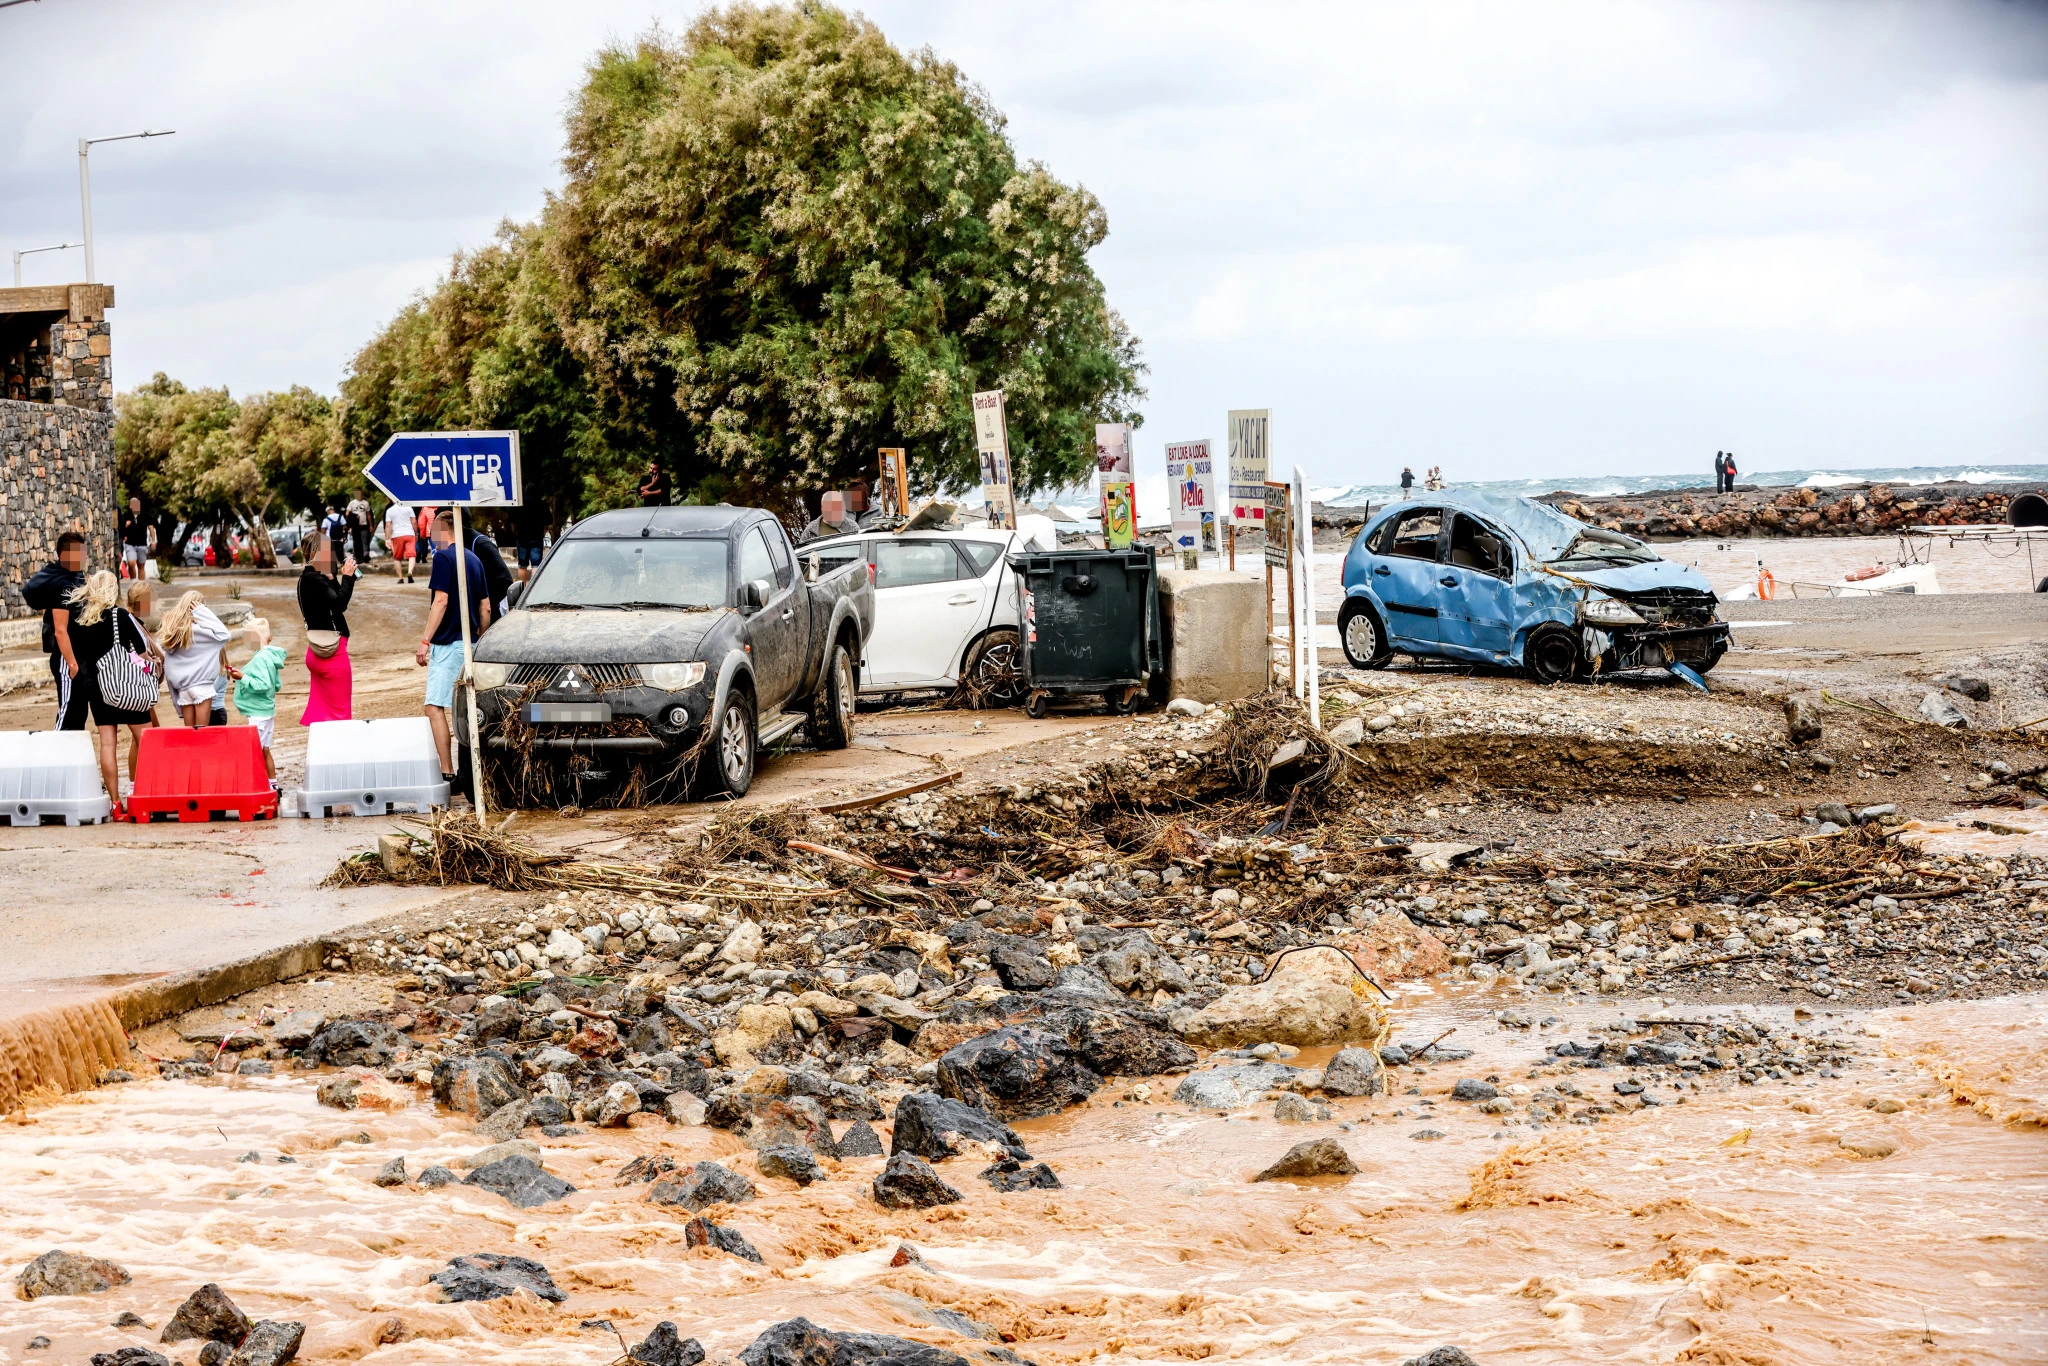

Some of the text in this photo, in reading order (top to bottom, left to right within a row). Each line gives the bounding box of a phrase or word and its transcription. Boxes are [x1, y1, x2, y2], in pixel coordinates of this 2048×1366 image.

[975, 397, 984, 410] Rent
[988, 395, 997, 408] Boat
[1239, 418, 1266, 458] YACHT
[1169, 448, 1177, 460] EAT
[1177, 446, 1188, 460] LIKE
[1193, 444, 1208, 458] LOCAL
[412, 455, 502, 485] CENTER
[1167, 461, 1212, 477] RESTAURANT SNACK BAR
[1242, 465, 1266, 482] Restaurant
